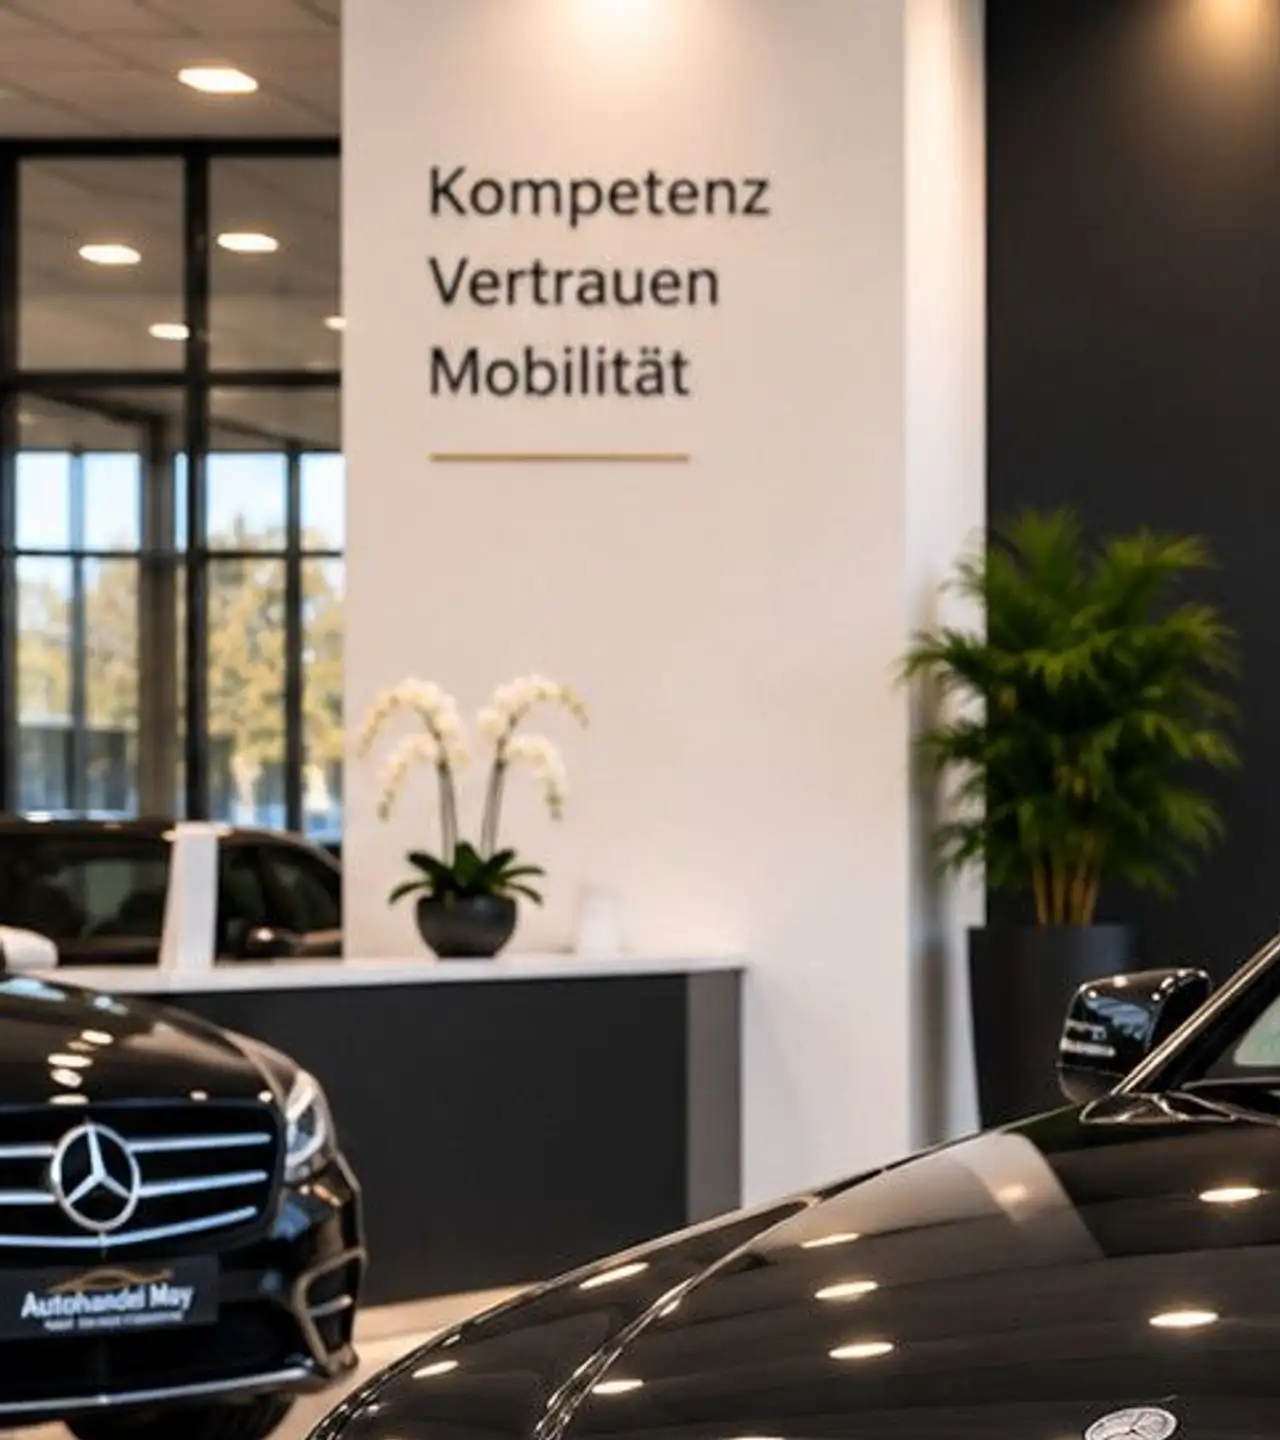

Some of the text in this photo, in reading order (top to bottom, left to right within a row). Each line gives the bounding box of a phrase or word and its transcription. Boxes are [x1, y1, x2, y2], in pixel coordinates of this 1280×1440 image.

[431, 167, 769, 227] Kompetenz
[429, 257, 718, 306] Vertrauen
[431, 347, 689, 396] Mobilität
